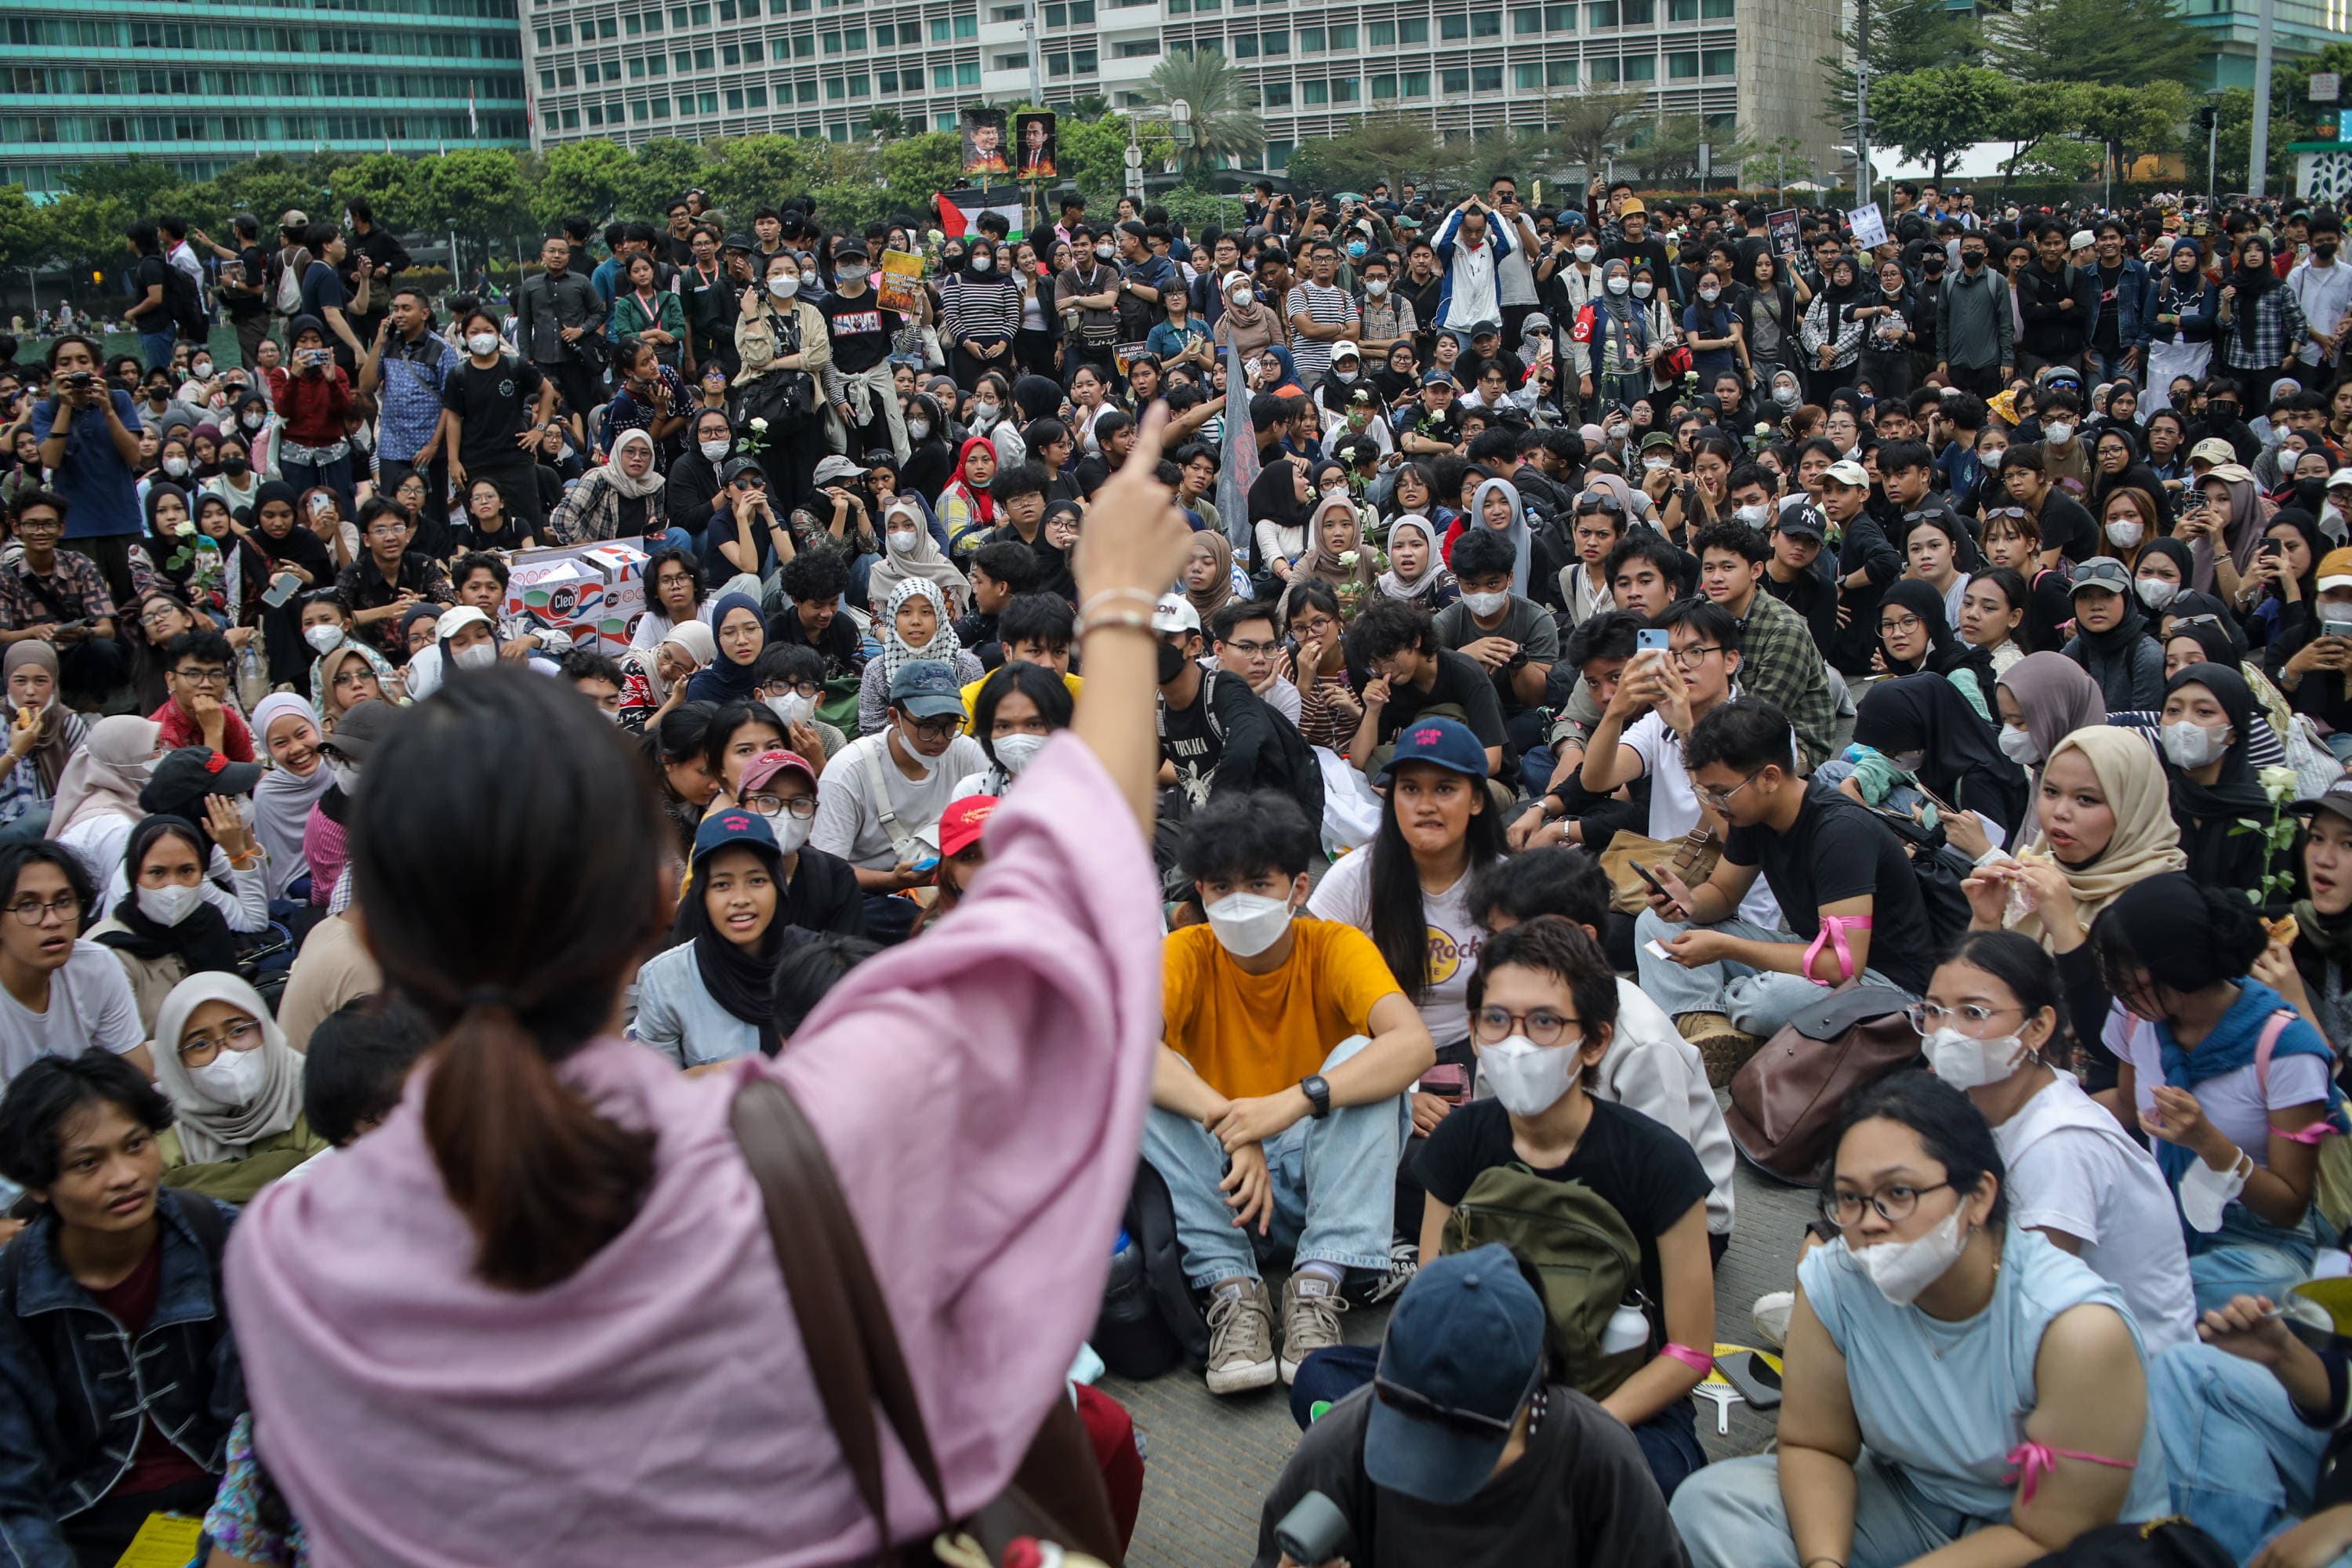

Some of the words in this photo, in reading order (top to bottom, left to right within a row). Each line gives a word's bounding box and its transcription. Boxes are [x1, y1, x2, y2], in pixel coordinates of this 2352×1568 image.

[1801, 508, 1817, 524] NY
[554, 595, 574, 609] Cleo
[608, 595, 619, 604] Cleo
[630, 621, 640, 634] Cl
[1428, 935, 1482, 964] Rock
